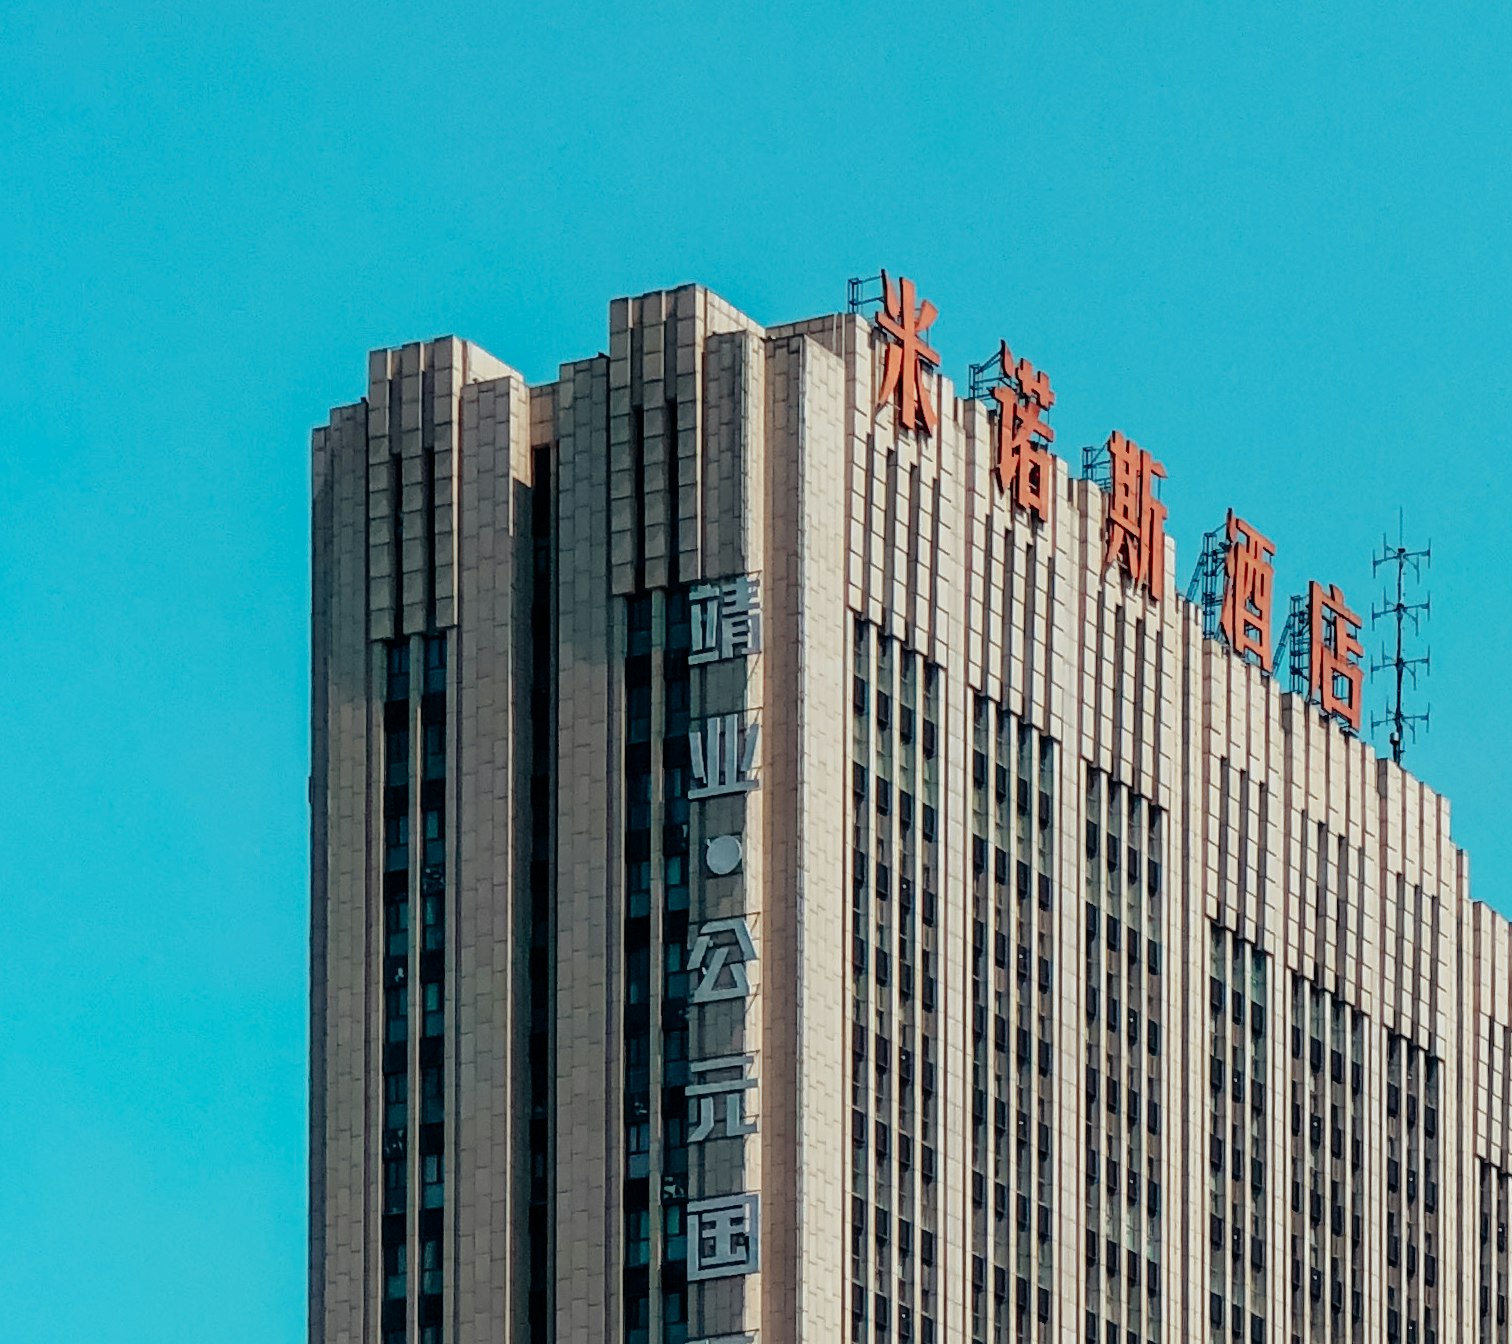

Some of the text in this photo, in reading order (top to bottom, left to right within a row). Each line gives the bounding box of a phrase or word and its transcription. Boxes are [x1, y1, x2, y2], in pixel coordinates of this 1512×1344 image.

[875, 269, 1364, 732] 米诺斯酒店
